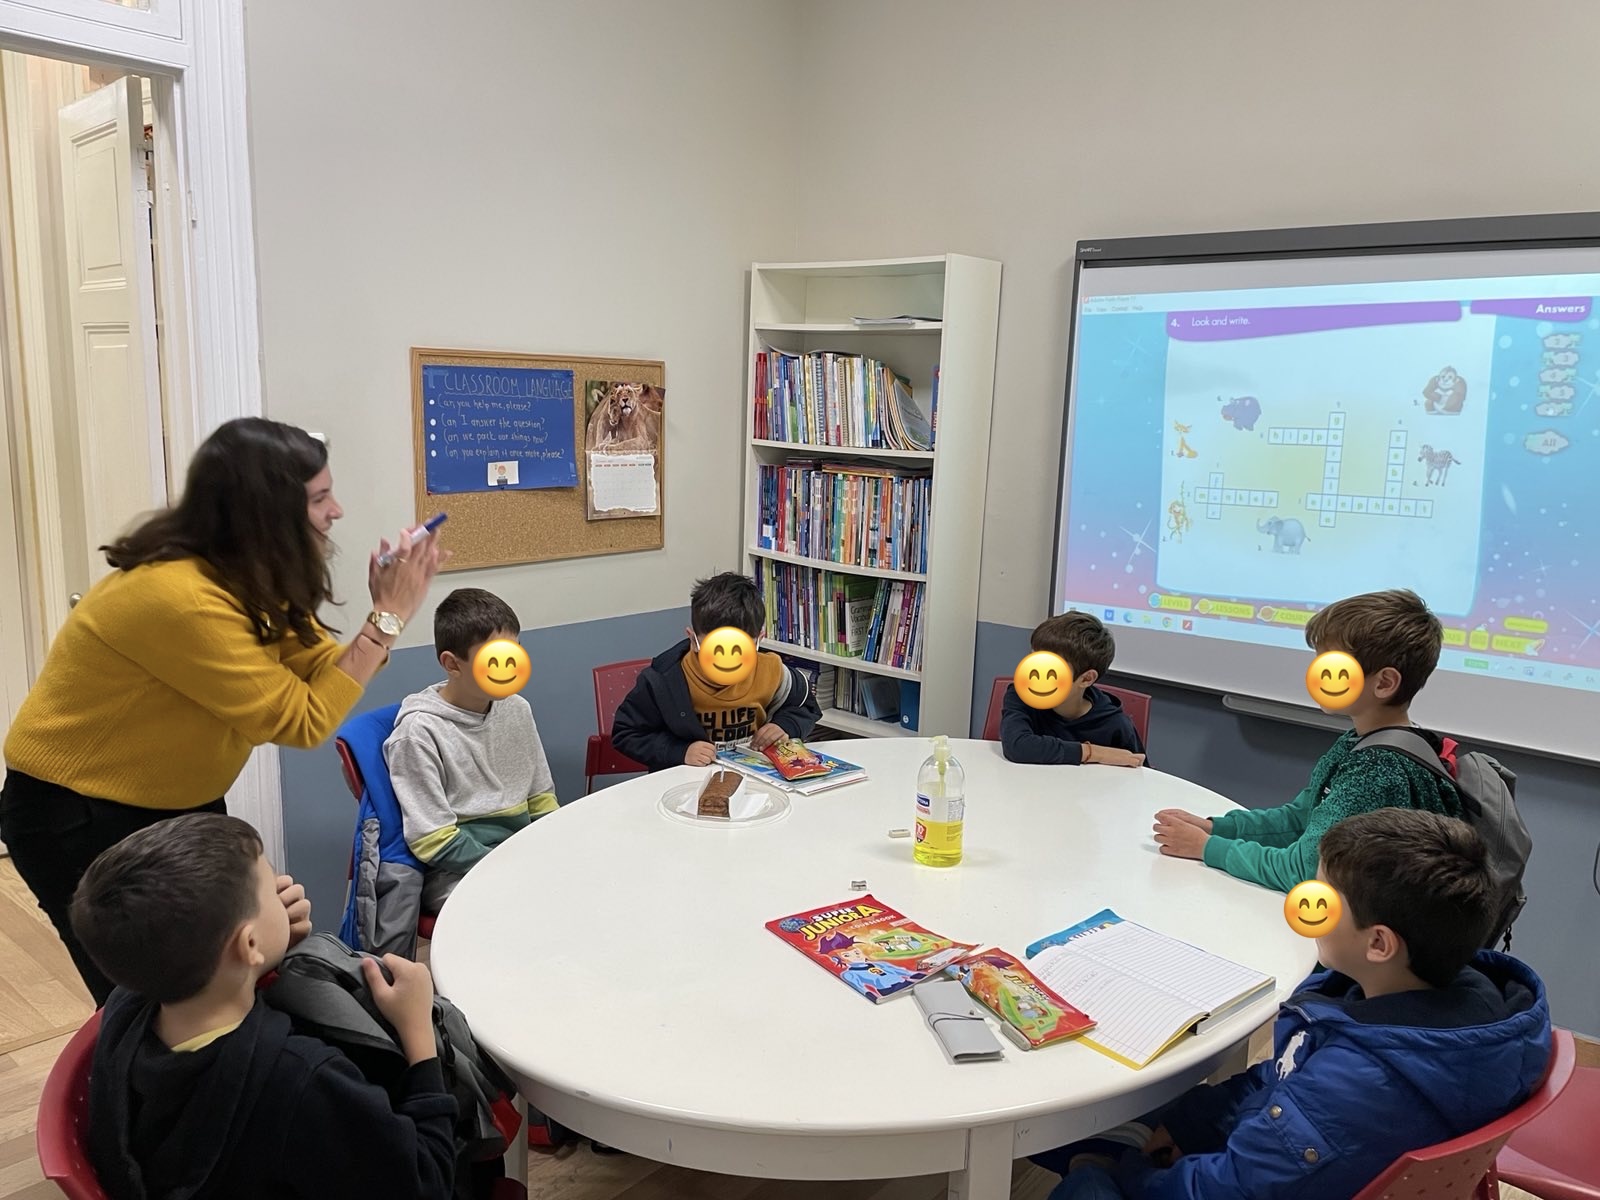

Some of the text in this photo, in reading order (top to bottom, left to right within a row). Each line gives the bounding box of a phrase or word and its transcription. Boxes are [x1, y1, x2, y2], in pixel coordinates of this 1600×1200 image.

[1536, 304, 1585, 313] Answers
[1170, 316, 1250, 327] 4. Look and write.
[444, 373, 574, 397] CLASSROOM LANGUAGE
[457, 400, 471, 415] you
[473, 400, 489, 411] help
[460, 415, 467, 425] I
[471, 418, 496, 427] answer
[499, 417, 511, 427] the
[513, 418, 545, 431] question?
[476, 432, 496, 444] pack
[462, 450, 474, 459] you
[721, 706, 757, 728] LIFE
[812, 906, 855, 922] SUPER
[800, 904, 884, 941] JUNIOR A
